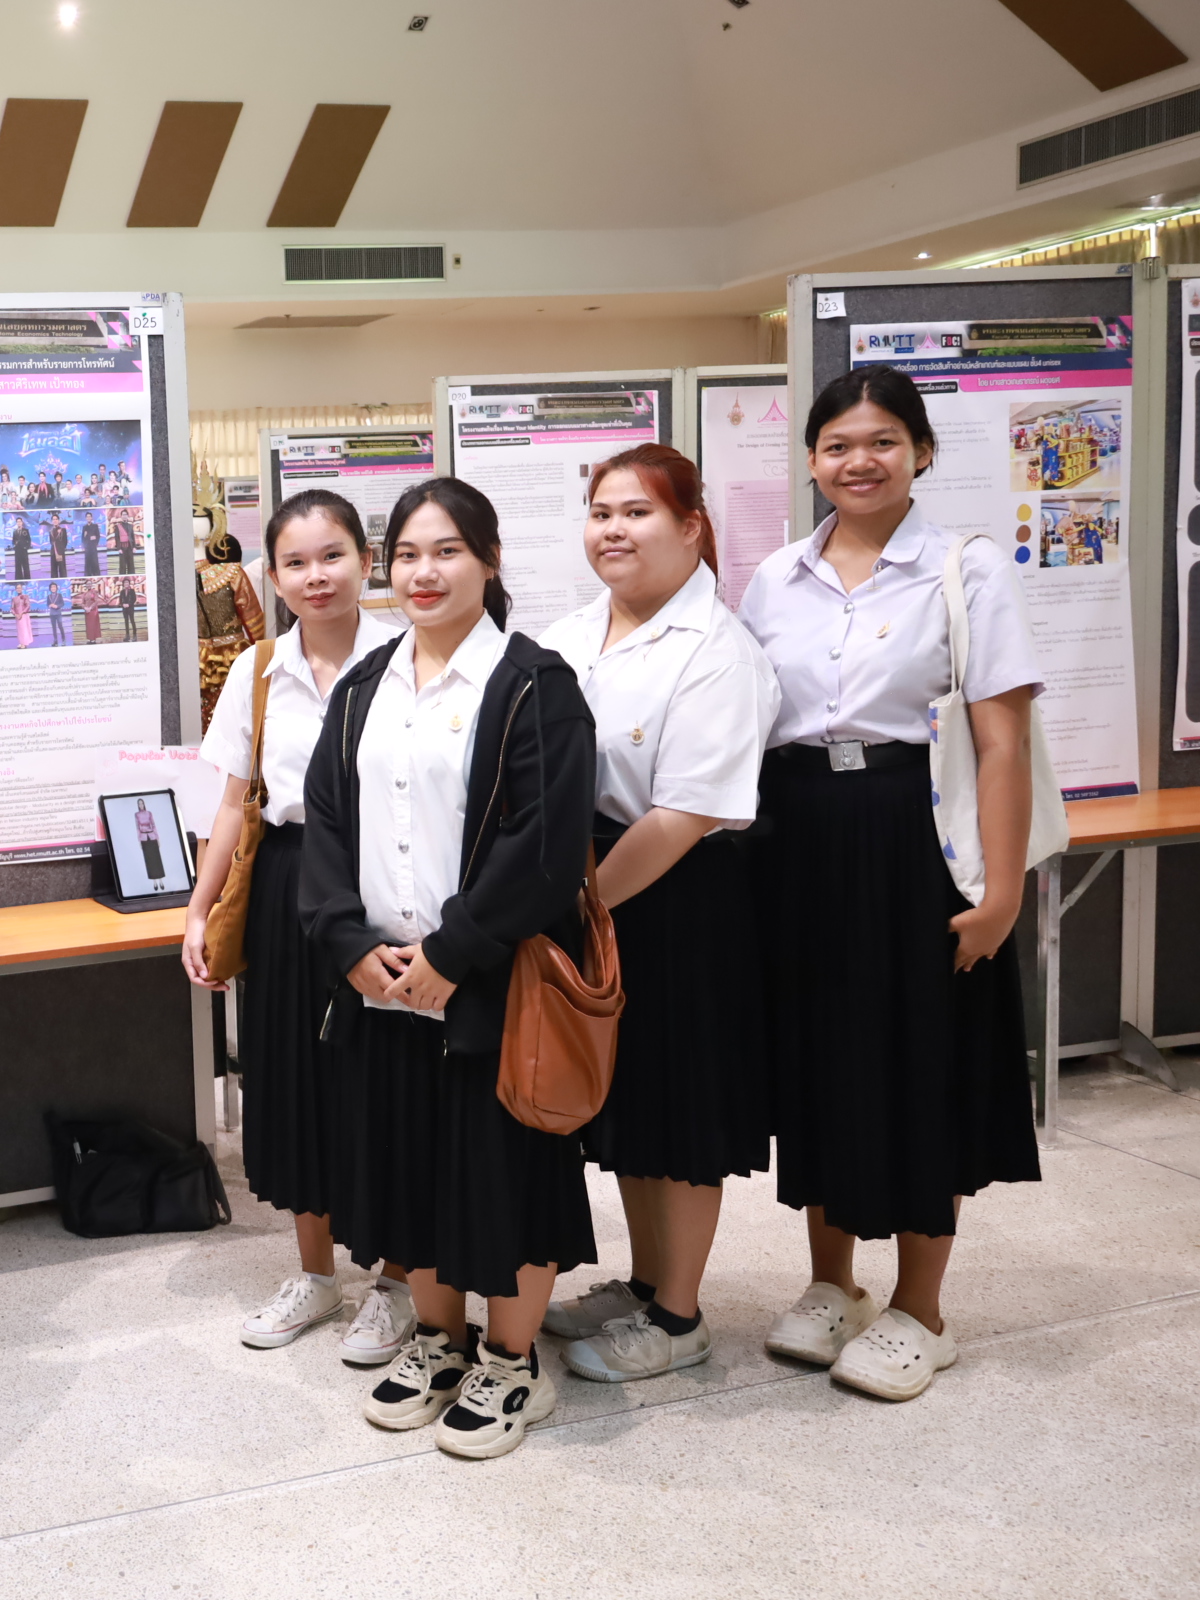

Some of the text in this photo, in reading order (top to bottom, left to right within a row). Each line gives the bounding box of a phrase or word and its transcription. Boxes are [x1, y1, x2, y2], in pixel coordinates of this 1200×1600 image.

[818, 302, 839, 313] D23
[134, 317, 157, 329] D25
[869, 334, 915, 348] RMUTT
[978, 377, 988, 386] โดย
[916, 383, 956, 391] ละเครื่องแต่งกาย
[451, 392, 466, 401] D20
[468, 405, 501, 414] RMUTT
[527, 424, 546, 432] Identity
[119, 749, 198, 762] Popular Vote
